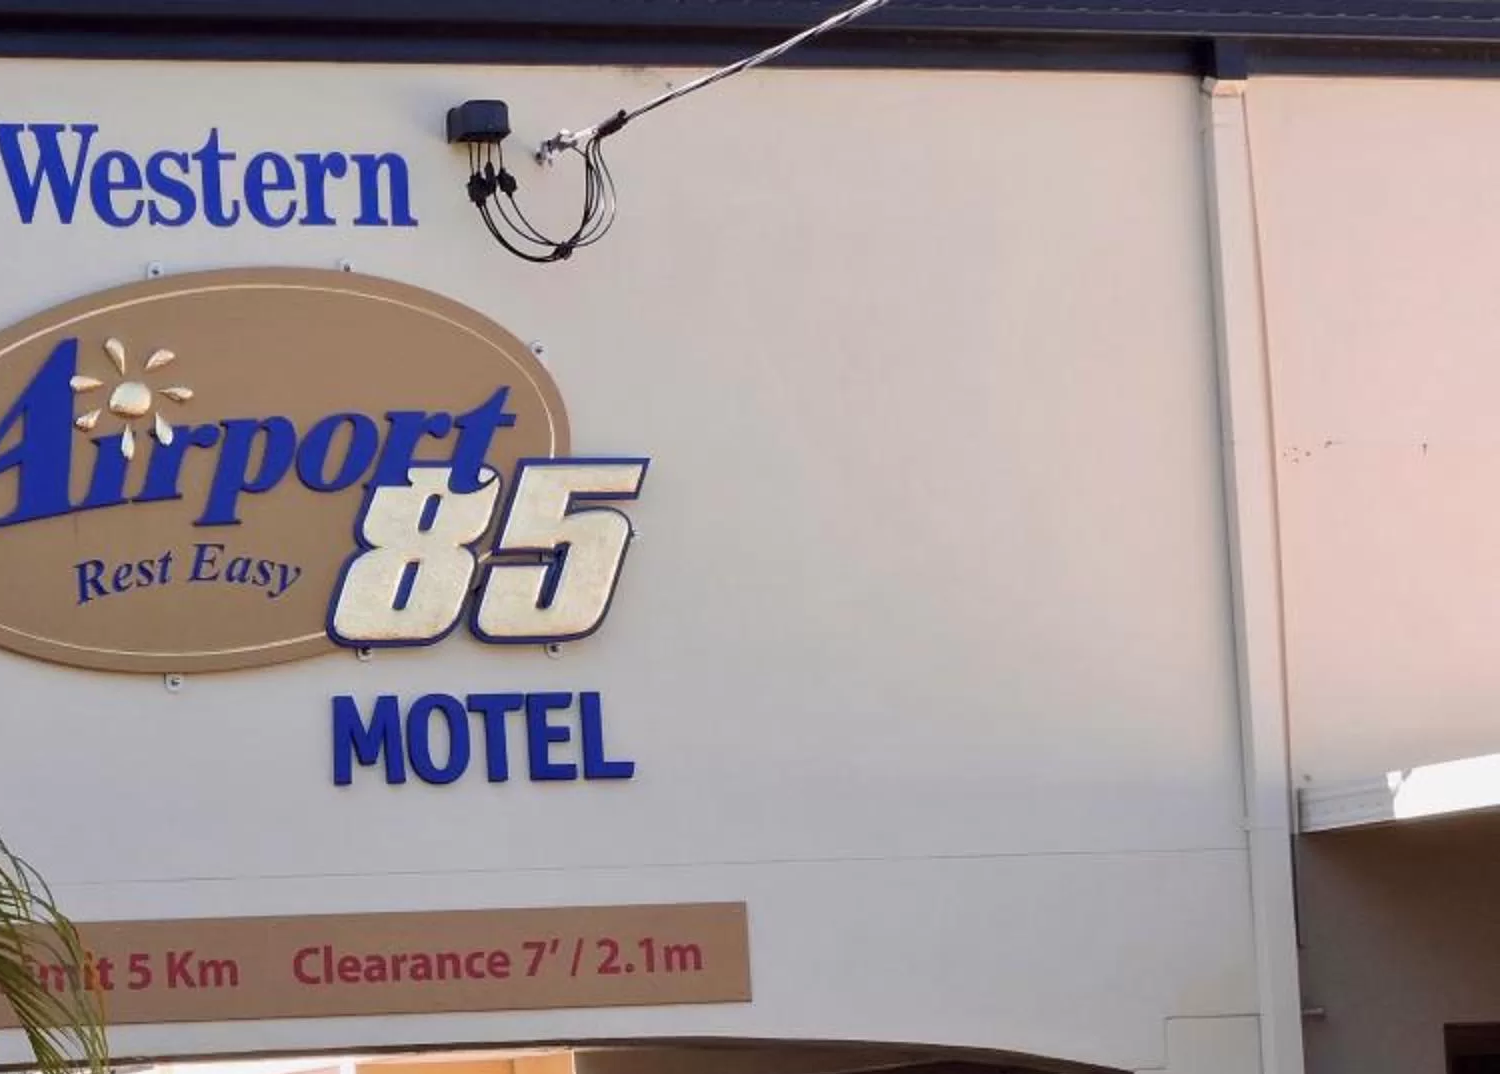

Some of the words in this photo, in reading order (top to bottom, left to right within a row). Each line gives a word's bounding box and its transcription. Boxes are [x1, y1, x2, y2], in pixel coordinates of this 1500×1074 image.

[73, 550, 173, 605] Rest
[187, 542, 302, 599] Easy
[325, 457, 651, 647] 85
[332, 691, 636, 786] MOTEL
[127, 953, 153, 990] 5
[166, 949, 240, 989] Km
[292, 944, 511, 985] Clearance
[596, 937, 703, 975] 2.1m
